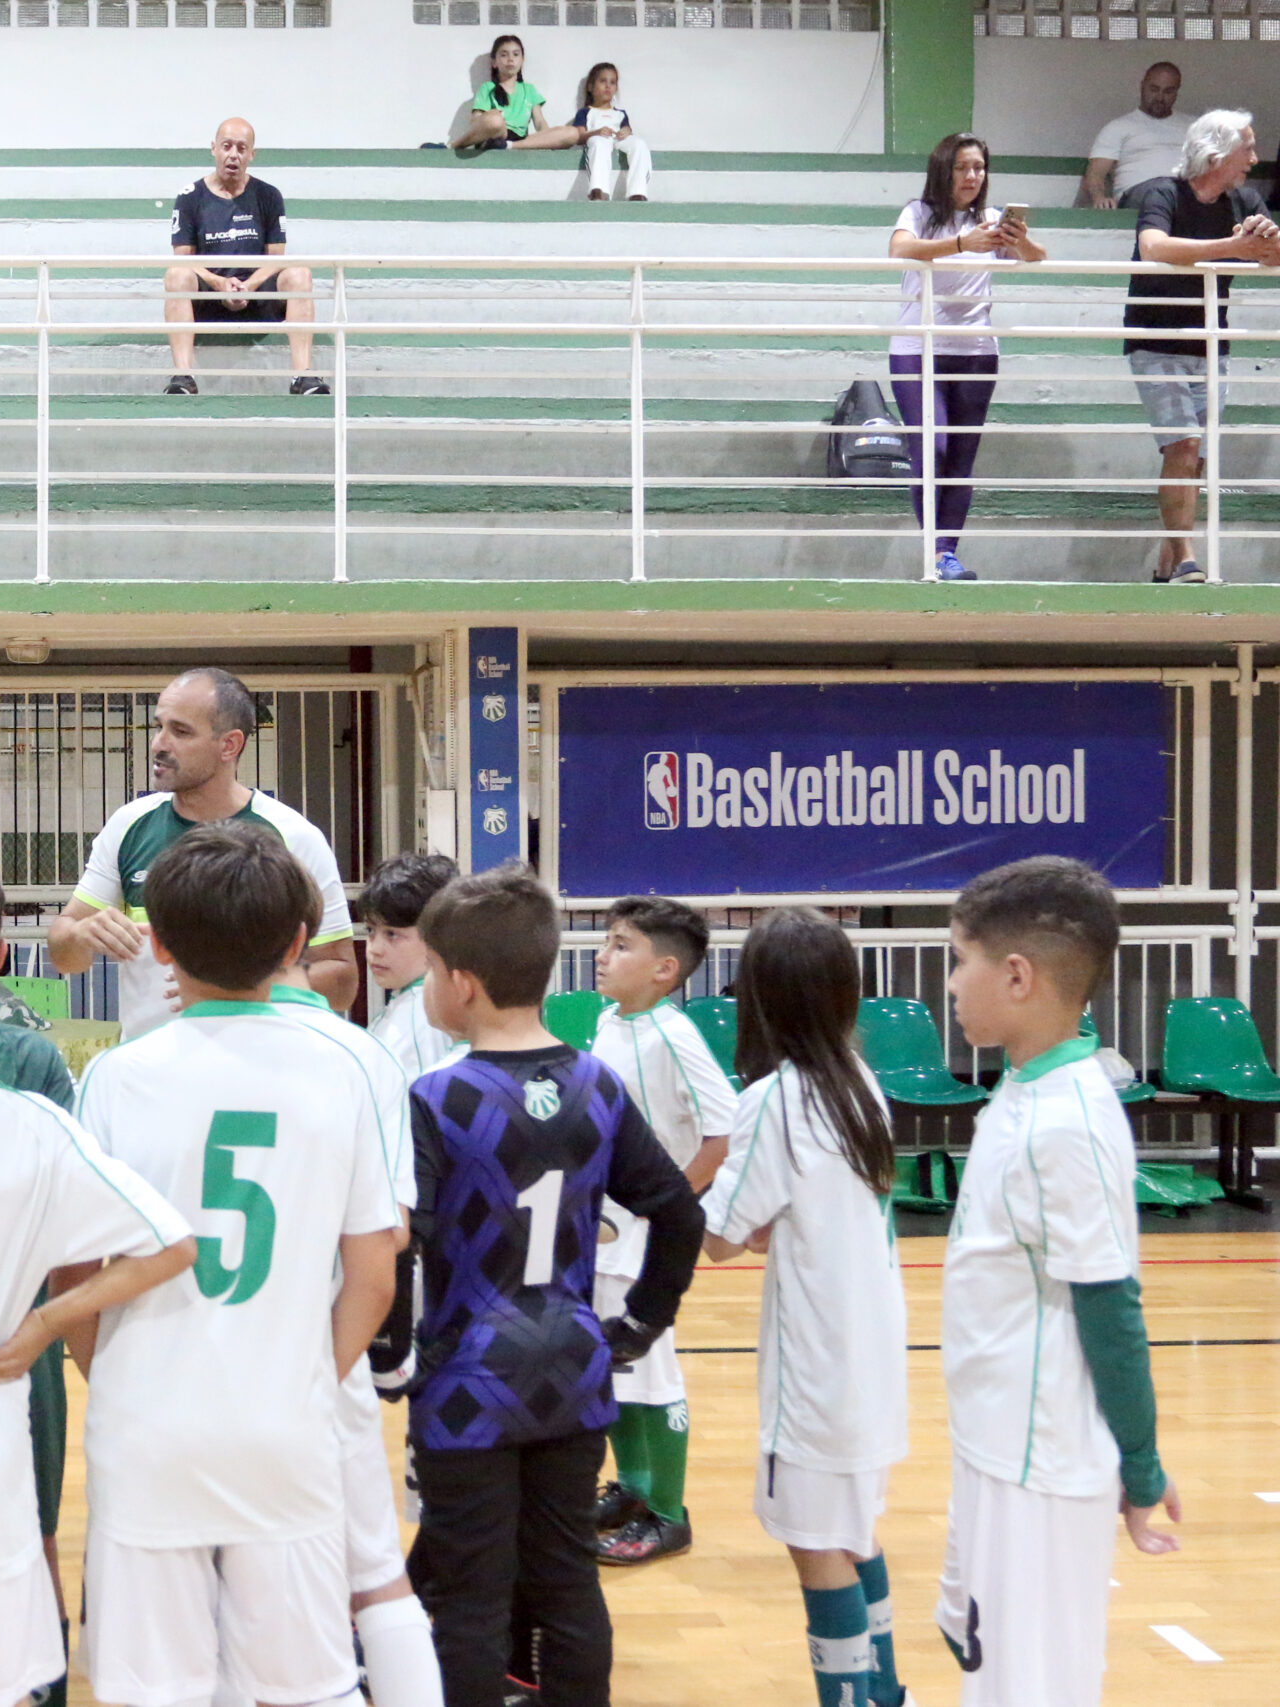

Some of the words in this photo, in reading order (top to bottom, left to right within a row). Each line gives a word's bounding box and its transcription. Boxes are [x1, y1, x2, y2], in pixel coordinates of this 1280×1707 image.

[650, 811, 666, 825] NBA
[686, 749, 924, 828] Basketball
[933, 748, 1086, 826] School
[192, 1110, 278, 1306] 5
[516, 1169, 564, 1286] 1
